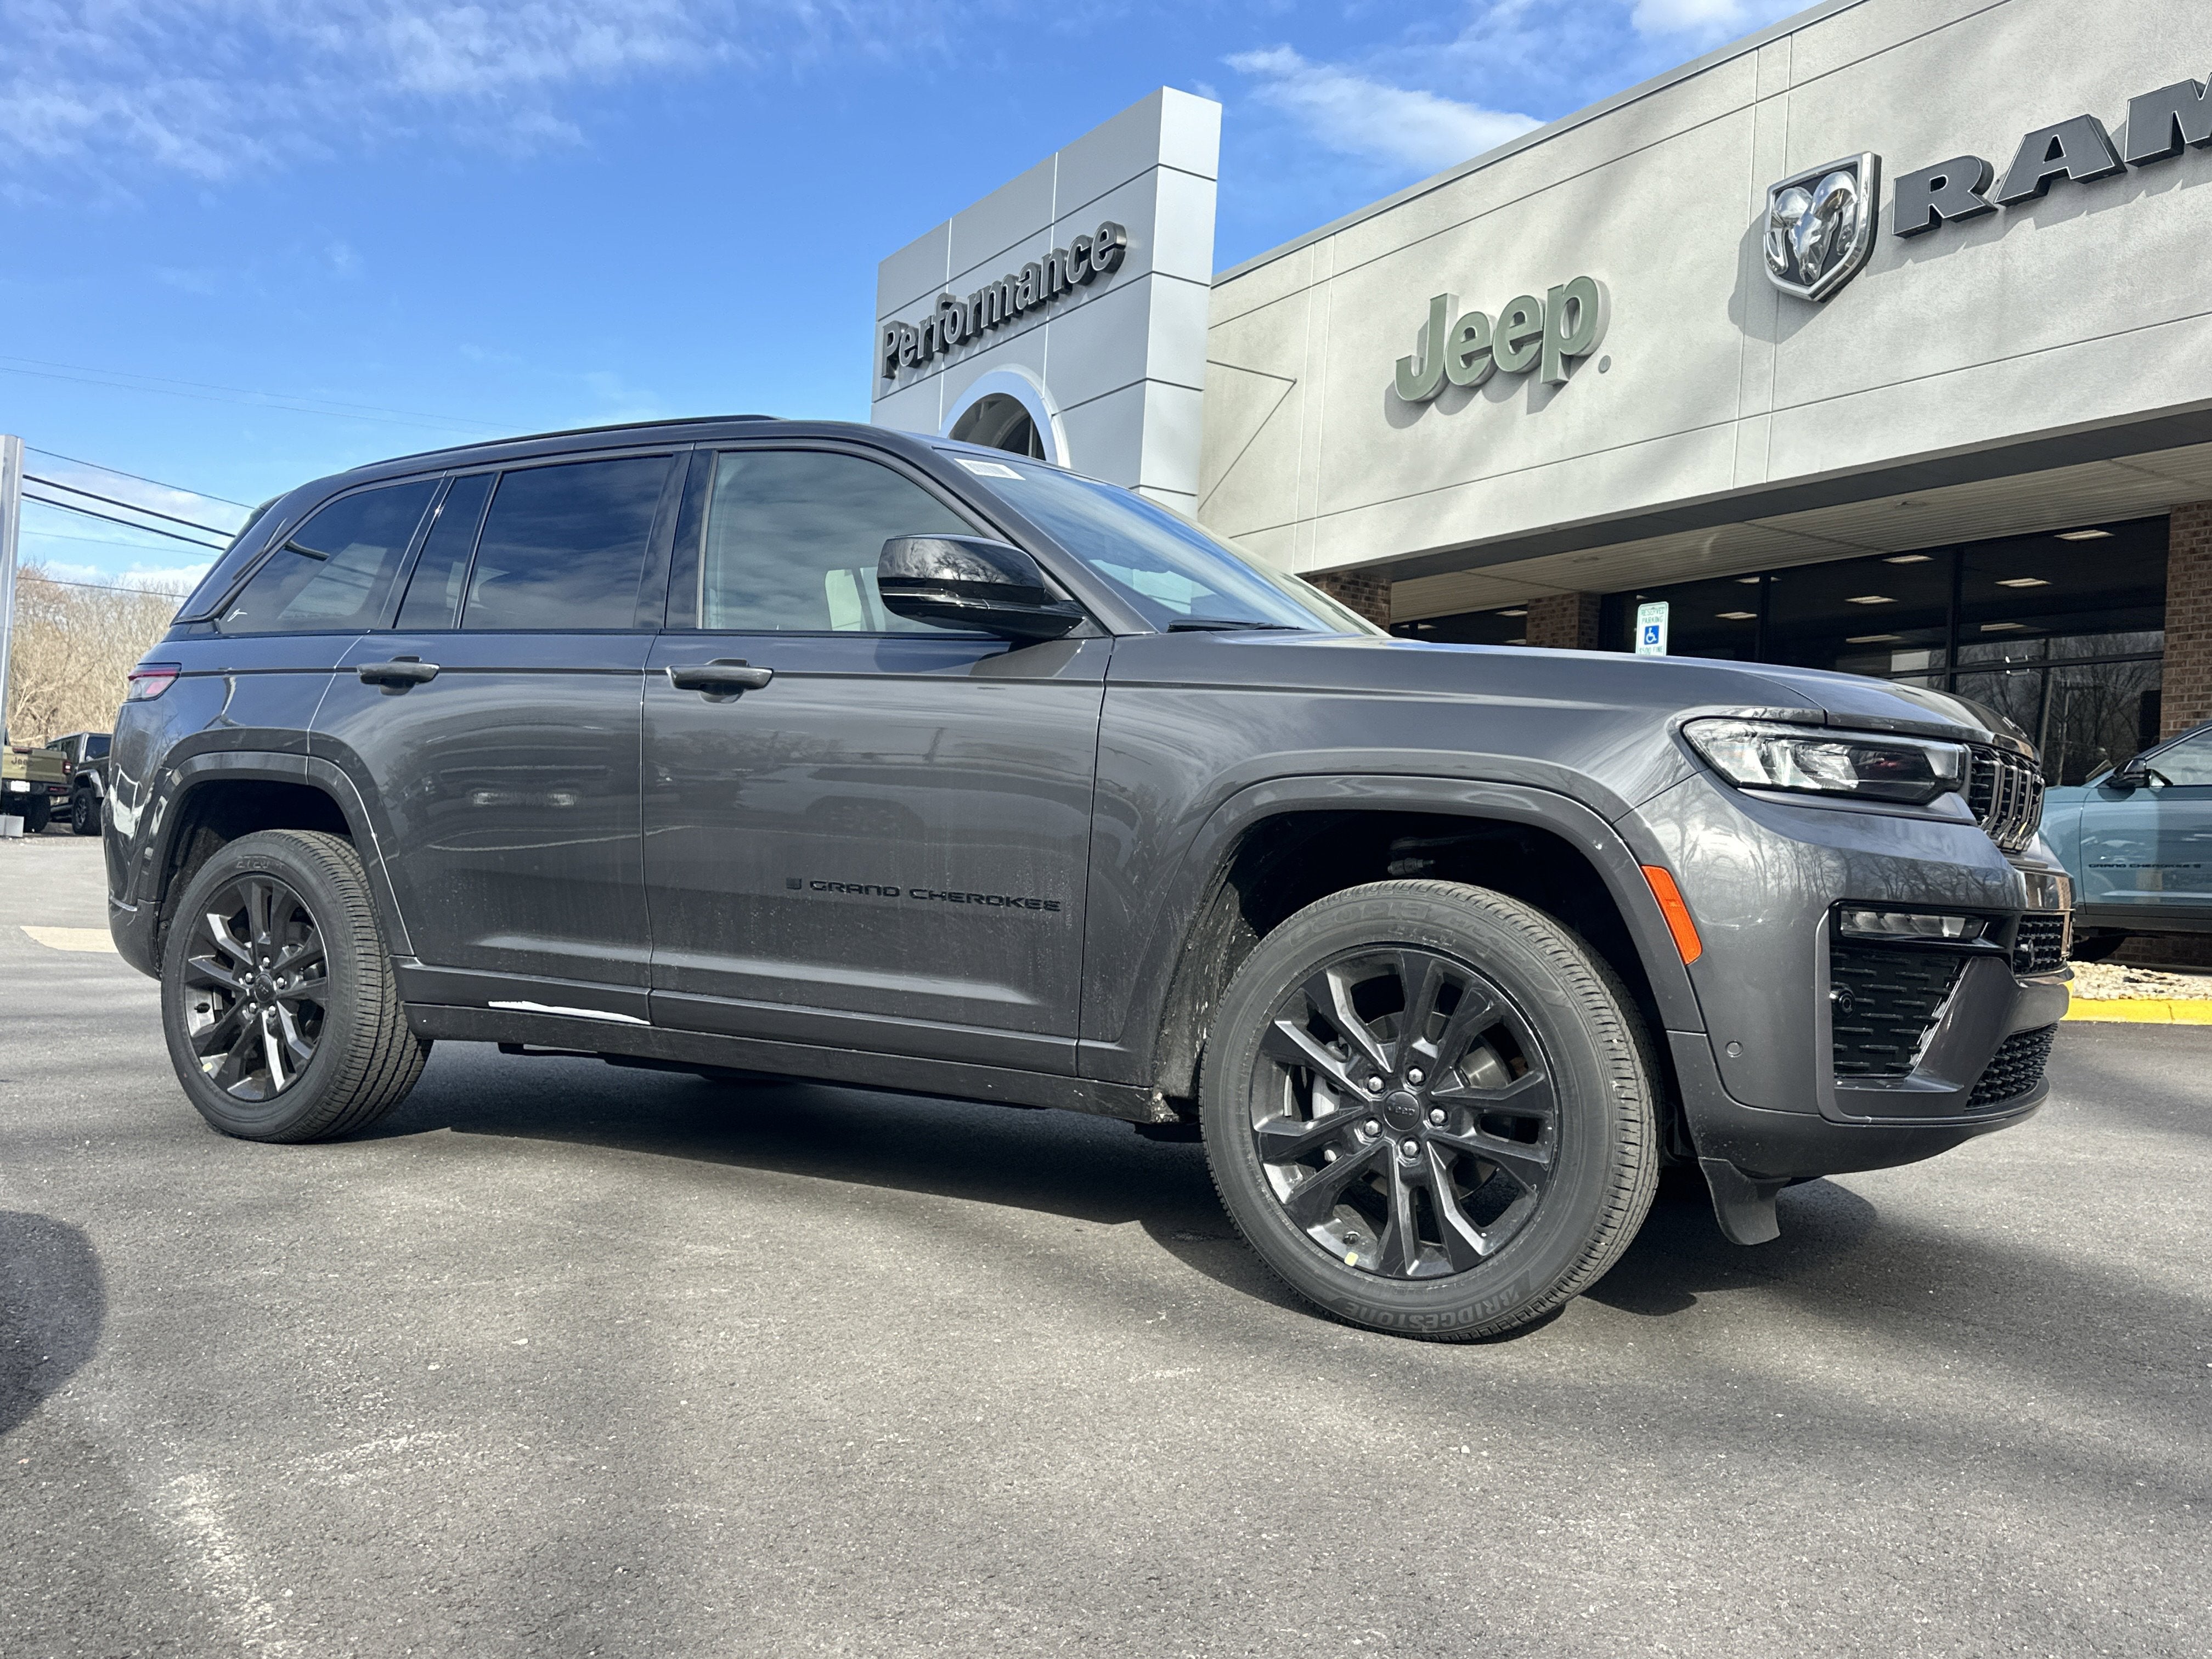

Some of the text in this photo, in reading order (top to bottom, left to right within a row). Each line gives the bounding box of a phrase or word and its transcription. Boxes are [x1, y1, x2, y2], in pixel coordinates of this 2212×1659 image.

[1891, 72, 2212, 240] RAM
[881, 221, 1127, 379] Performance
[1395, 275, 1611, 402] Jeep
[1641, 616, 1663, 624] PARKING
[11, 757, 33, 766] Jeep
[810, 880, 1061, 912] GRAND CHEROKEE
[1290, 902, 1431, 947] ECOPIA
[1344, 1284, 1520, 1330] BRIDGESTONE
